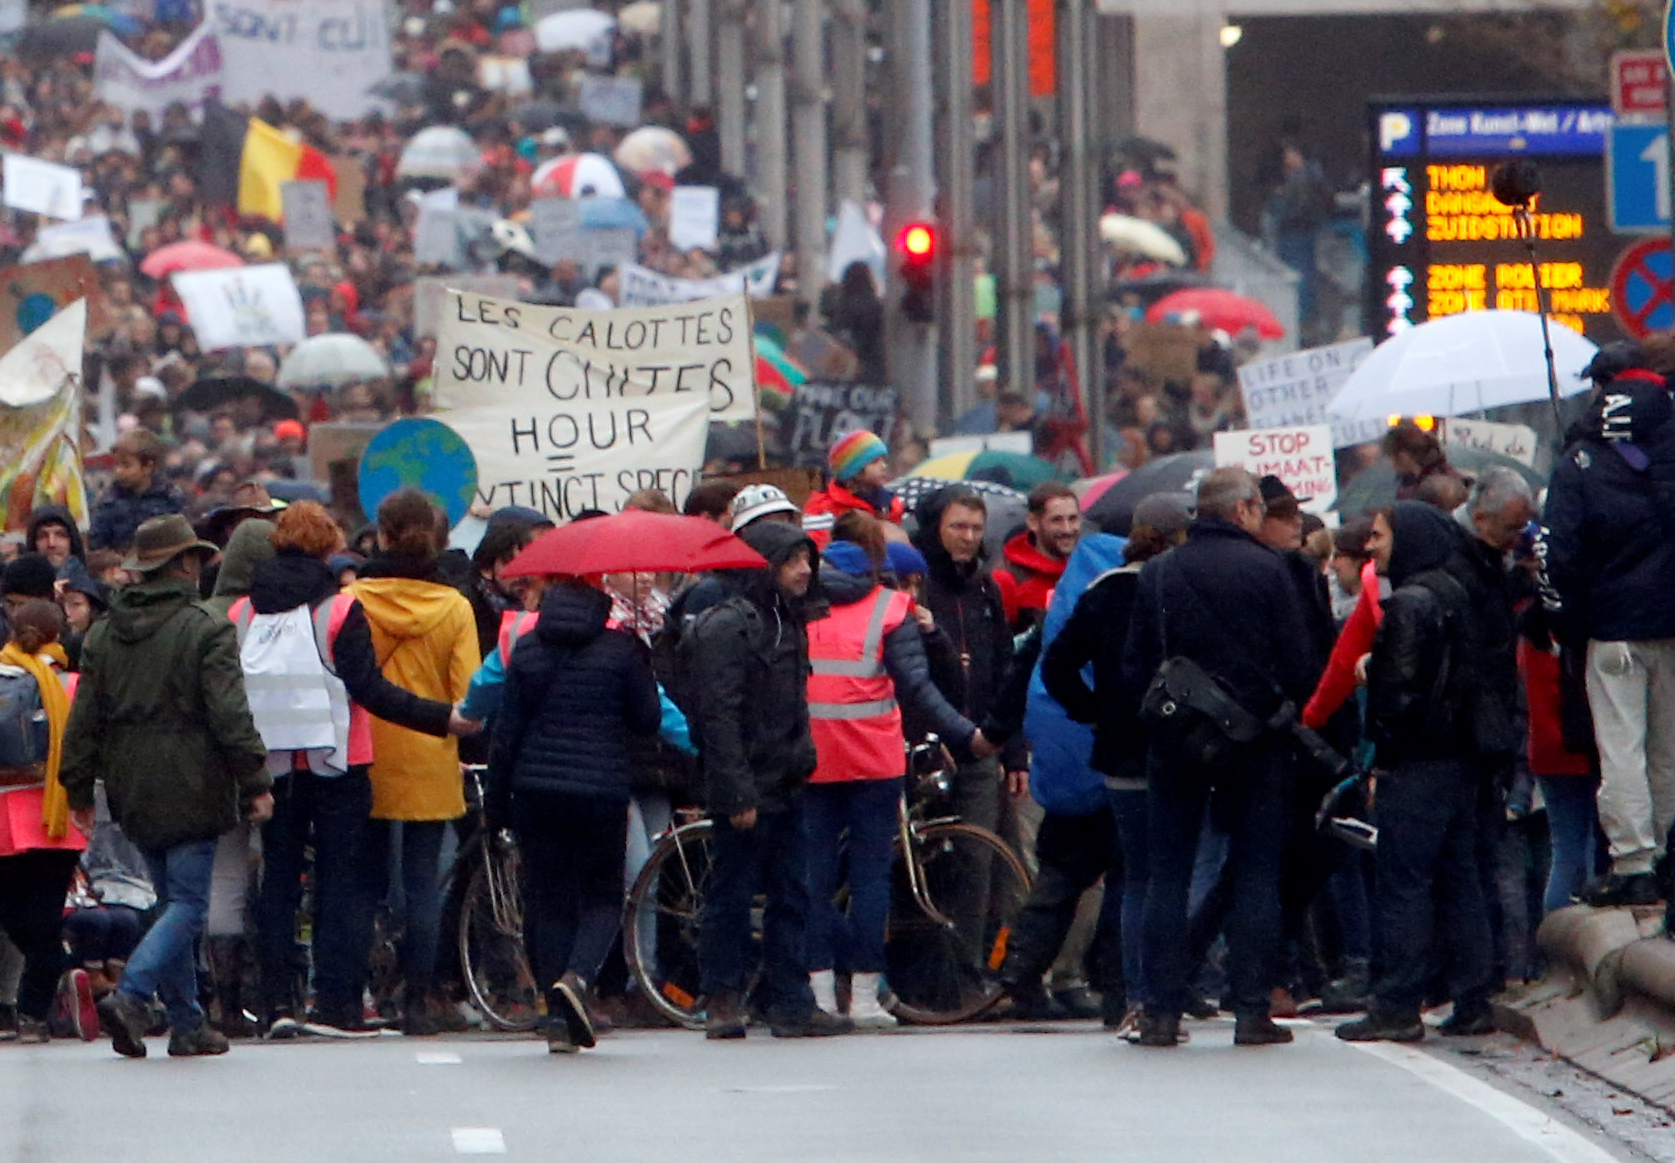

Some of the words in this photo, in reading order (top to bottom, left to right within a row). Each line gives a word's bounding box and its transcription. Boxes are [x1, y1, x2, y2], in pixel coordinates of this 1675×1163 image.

[1381, 112, 1411, 151] P
[1426, 165, 1485, 190] THON
[457, 295, 522, 329] LES
[548, 307, 733, 350] CALOTTES
[452, 345, 533, 387] SONT
[511, 409, 653, 455] HOUR
[1249, 433, 1309, 456] STOP
